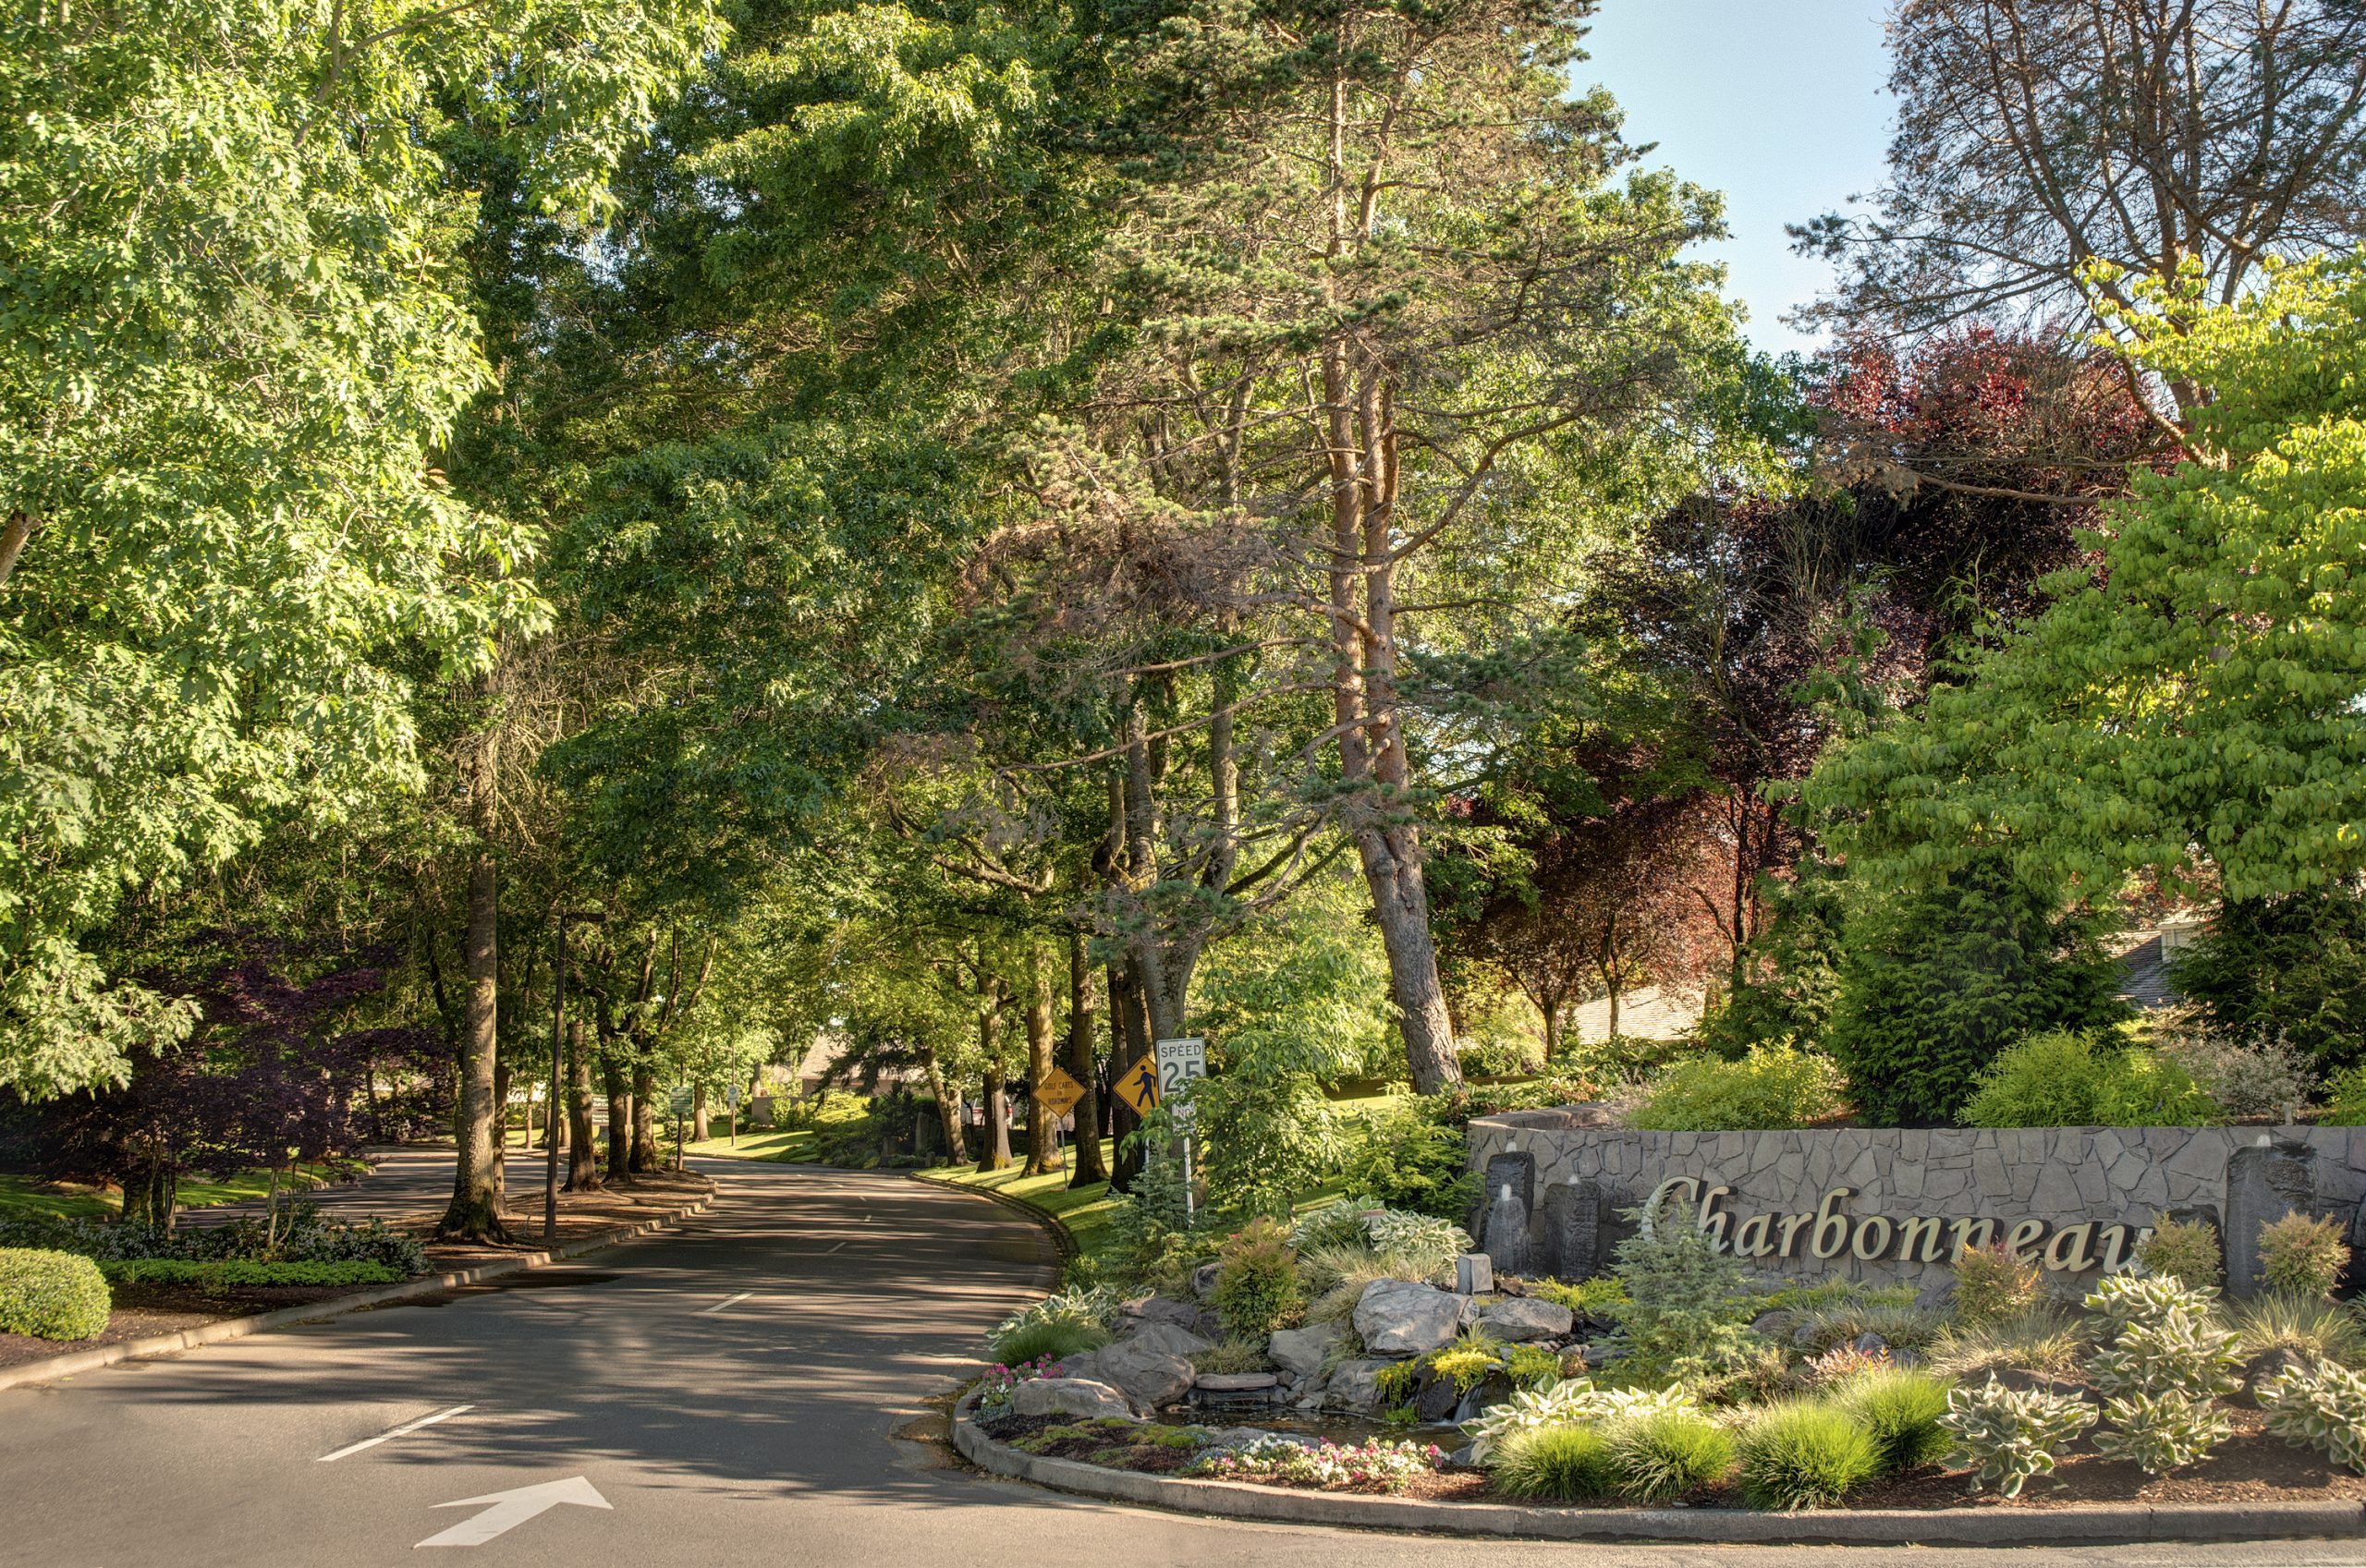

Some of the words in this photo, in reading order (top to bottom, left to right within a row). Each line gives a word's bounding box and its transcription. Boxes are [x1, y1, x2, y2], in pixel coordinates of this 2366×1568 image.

[1161, 1044, 1201, 1058] SPEED
[1163, 1060, 1201, 1093] 25
[1044, 1082, 1056, 1090] GOLF
[1048, 1097, 1073, 1105] ROADWAYS
[1640, 1175, 2157, 1276] Charbonneau
